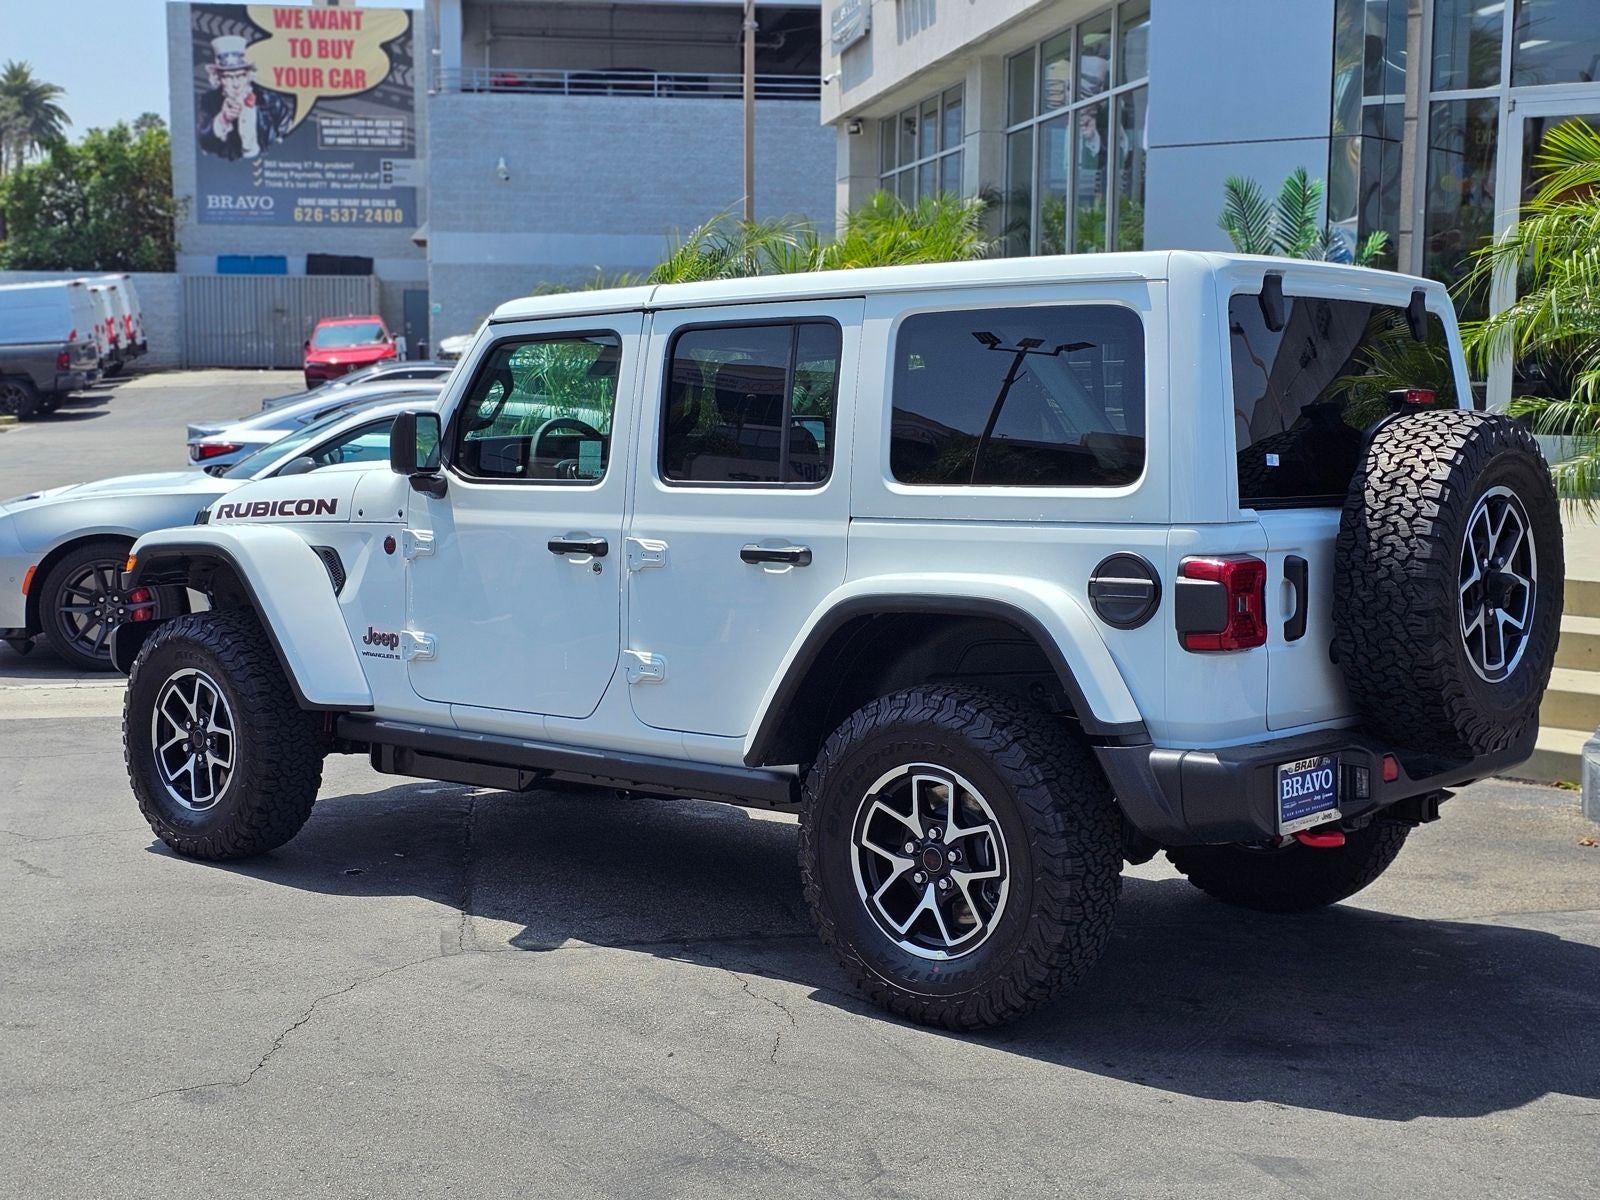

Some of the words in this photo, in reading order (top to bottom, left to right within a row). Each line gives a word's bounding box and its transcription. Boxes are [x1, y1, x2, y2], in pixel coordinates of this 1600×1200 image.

[273, 8, 303, 29] WE
[308, 9, 363, 31] WANT
[288, 38, 312, 59] TO
[317, 39, 355, 60] BUY
[273, 67, 324, 88] YOUR
[328, 68, 367, 89] CAR
[206, 194, 275, 210] BRAVO
[293, 207, 404, 223] 626-537-2400
[216, 498, 339, 520] RUBICON
[362, 626, 400, 651] Jeep
[361, 650, 395, 660] WRANGLER
[1294, 757, 1322, 772] BRAV
[1282, 769, 1333, 799] BRAVO
